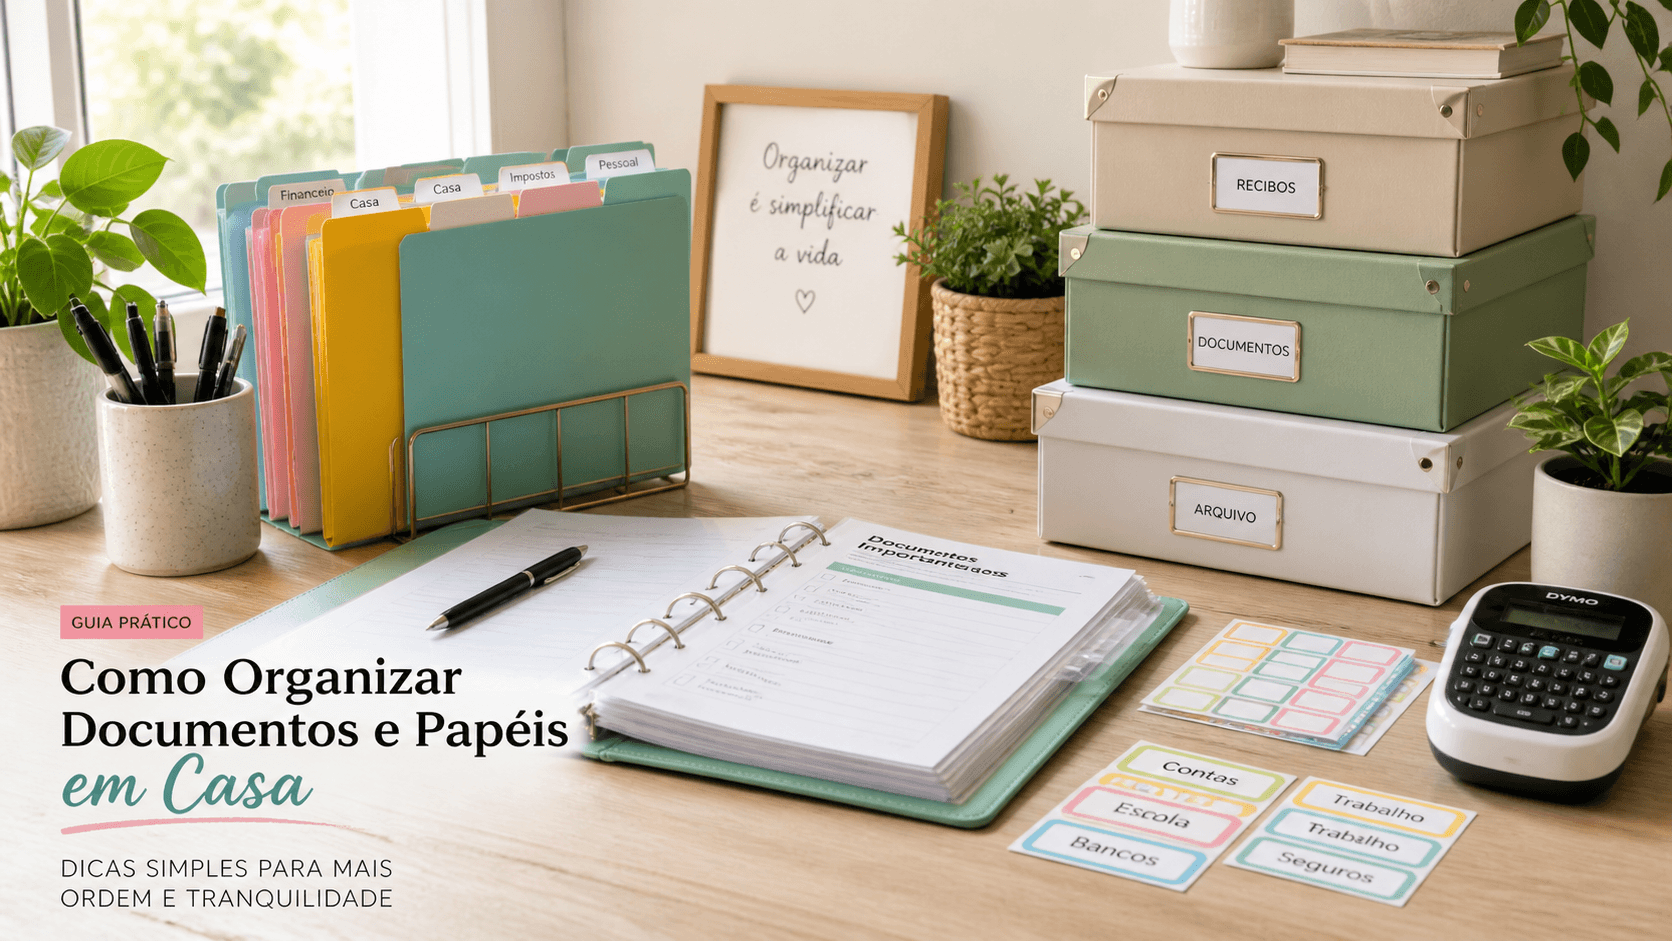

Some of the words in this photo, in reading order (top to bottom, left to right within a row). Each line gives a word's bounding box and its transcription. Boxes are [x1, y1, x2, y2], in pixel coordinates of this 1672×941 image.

[598, 156, 640, 171] Pessoal
[763, 141, 868, 184] Organizar
[433, 181, 462, 195] Casa
[509, 168, 556, 185] Impostos
[1236, 178, 1296, 194] RECIBOS
[350, 198, 380, 210] Casa
[750, 192, 760, 213] é
[769, 191, 878, 231] simplificar
[774, 247, 787, 262] a
[797, 238, 843, 267] vida
[1197, 336, 1291, 358] DOCUMENTOS
[1193, 503, 1257, 524] ARQUIVO
[1545, 592, 1599, 606] DYMO
[1162, 760, 1239, 787] Contas
[1113, 802, 1190, 829] Escola
[1333, 793, 1425, 824] Trabalho
[1308, 821, 1400, 853] Trabalho
[1069, 835, 1159, 868] Bancos
[1277, 851, 1375, 885] Seguros
